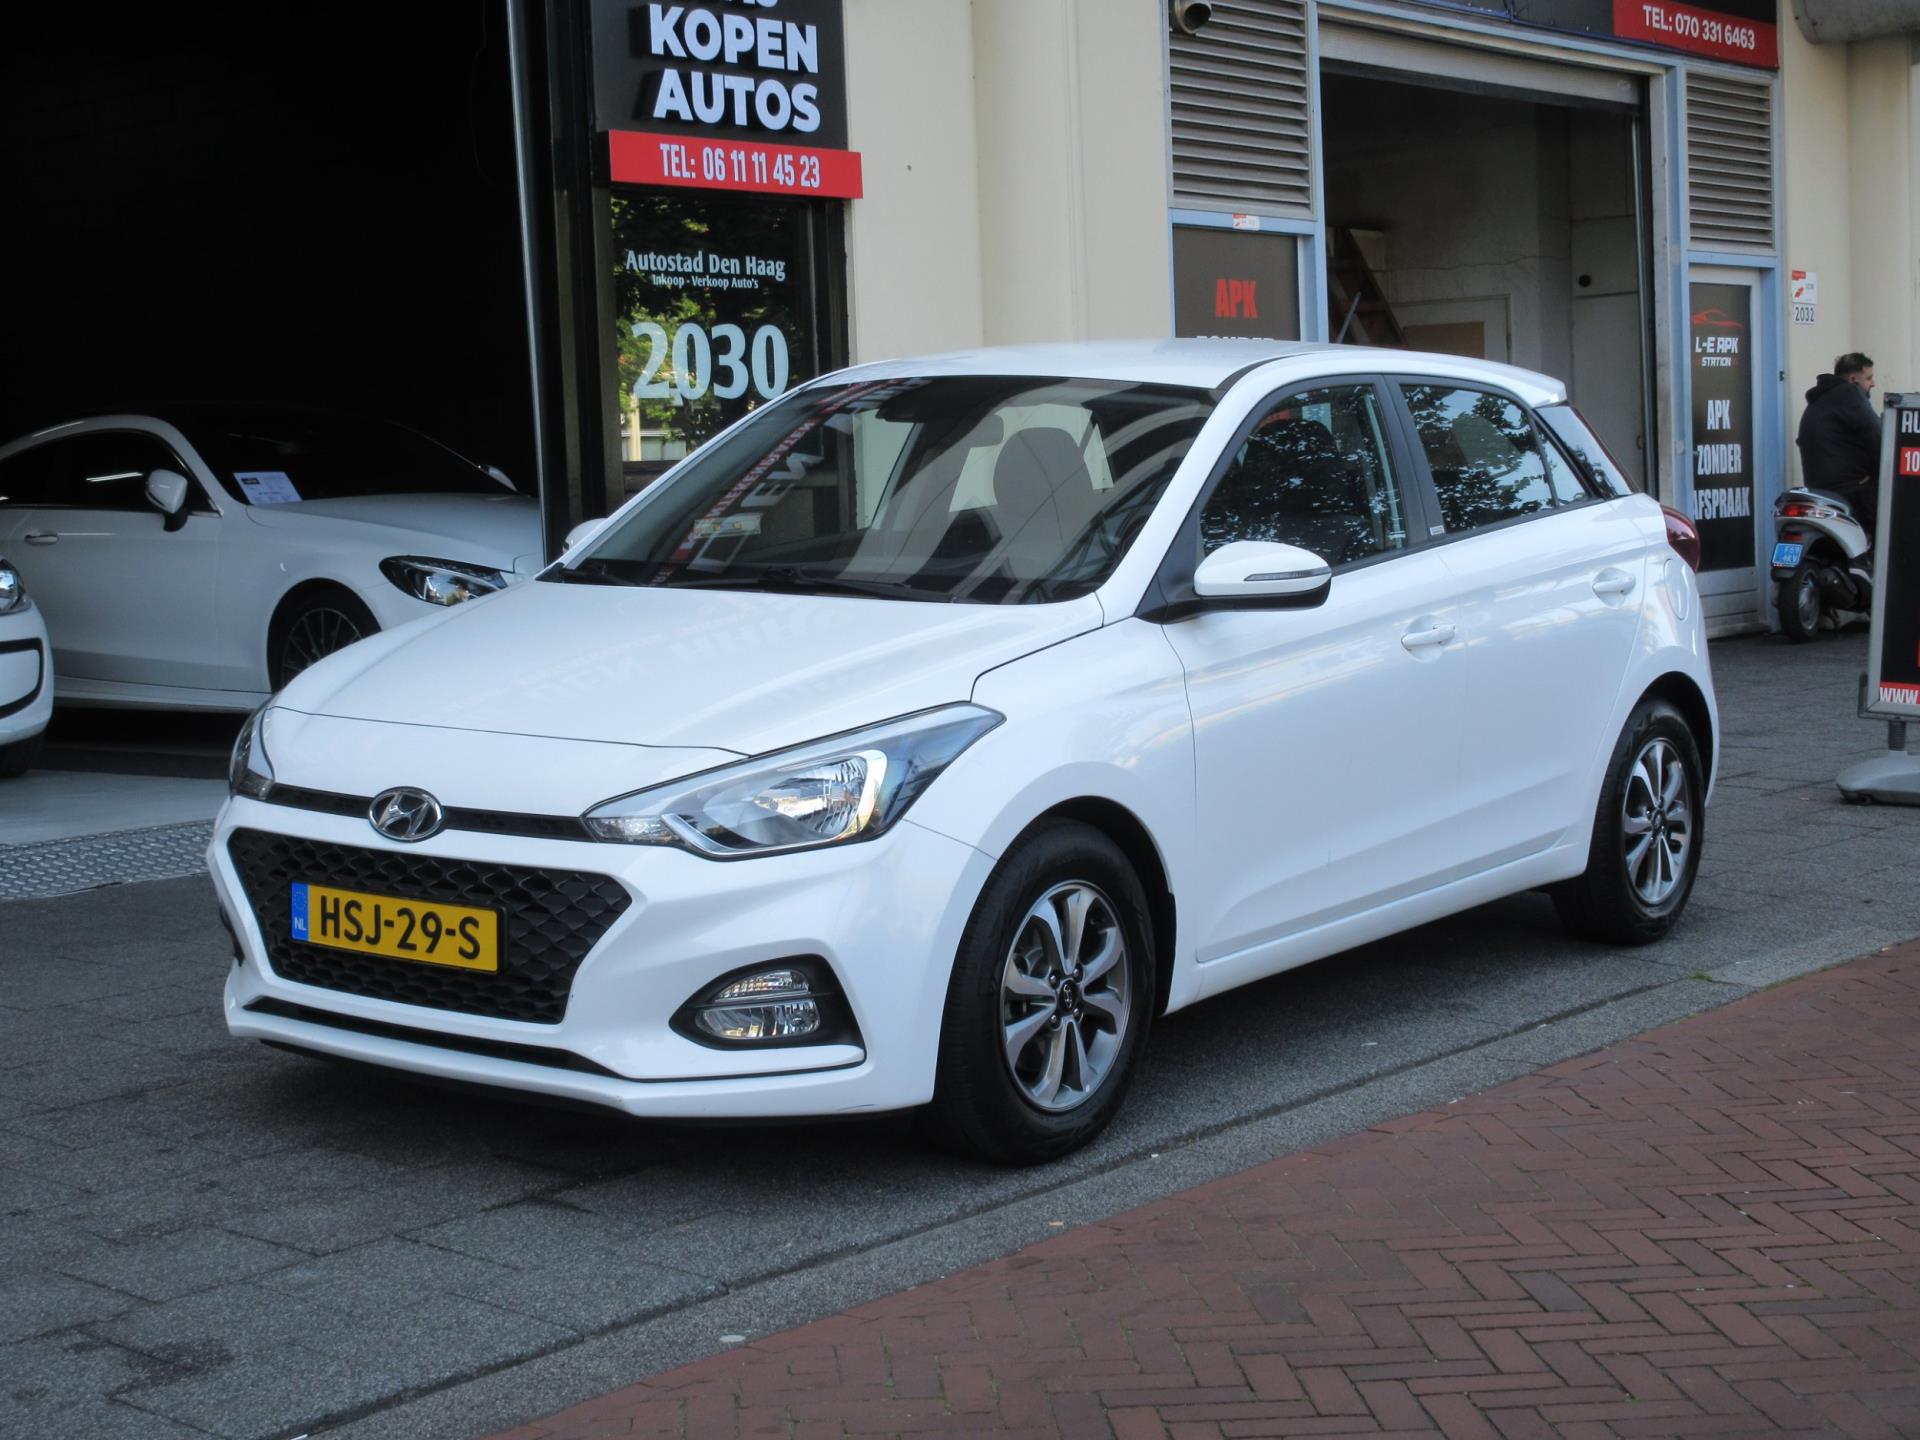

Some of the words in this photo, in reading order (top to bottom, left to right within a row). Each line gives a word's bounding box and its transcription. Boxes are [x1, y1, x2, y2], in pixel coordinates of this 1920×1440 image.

[649, 4, 819, 73] KOPEN
[1643, 5, 1673, 32] TEL:
[1675, 13, 1700, 38] 070
[1702, 20, 1722, 44] 331
[1725, 25, 1756, 50] 6463
[653, 68, 821, 133] AUTOS
[660, 143, 696, 179] TEL:
[703, 147, 726, 182] 06
[730, 150, 747, 183] 11
[752, 151, 768, 184] 11
[773, 154, 795, 187] 45
[800, 155, 820, 188] 23
[625, 249, 704, 273] Autostad
[709, 254, 741, 275] Den
[746, 256, 786, 282] Haag
[652, 274, 685, 289] Inkoop
[692, 275, 730, 291] Verkoop
[731, 277, 759, 289] Auto's
[1215, 278, 1258, 319] APK
[1795, 306, 1814, 322] 2032
[631, 322, 790, 402] 2030
[1701, 356, 1732, 367] STATION
[1707, 399, 1731, 430] APK
[1697, 443, 1742, 475] ZONDER
[1693, 486, 1751, 520] AFSPRAAK
[294, 916, 307, 931] NL
[320, 894, 481, 960] HSJ-29-S
